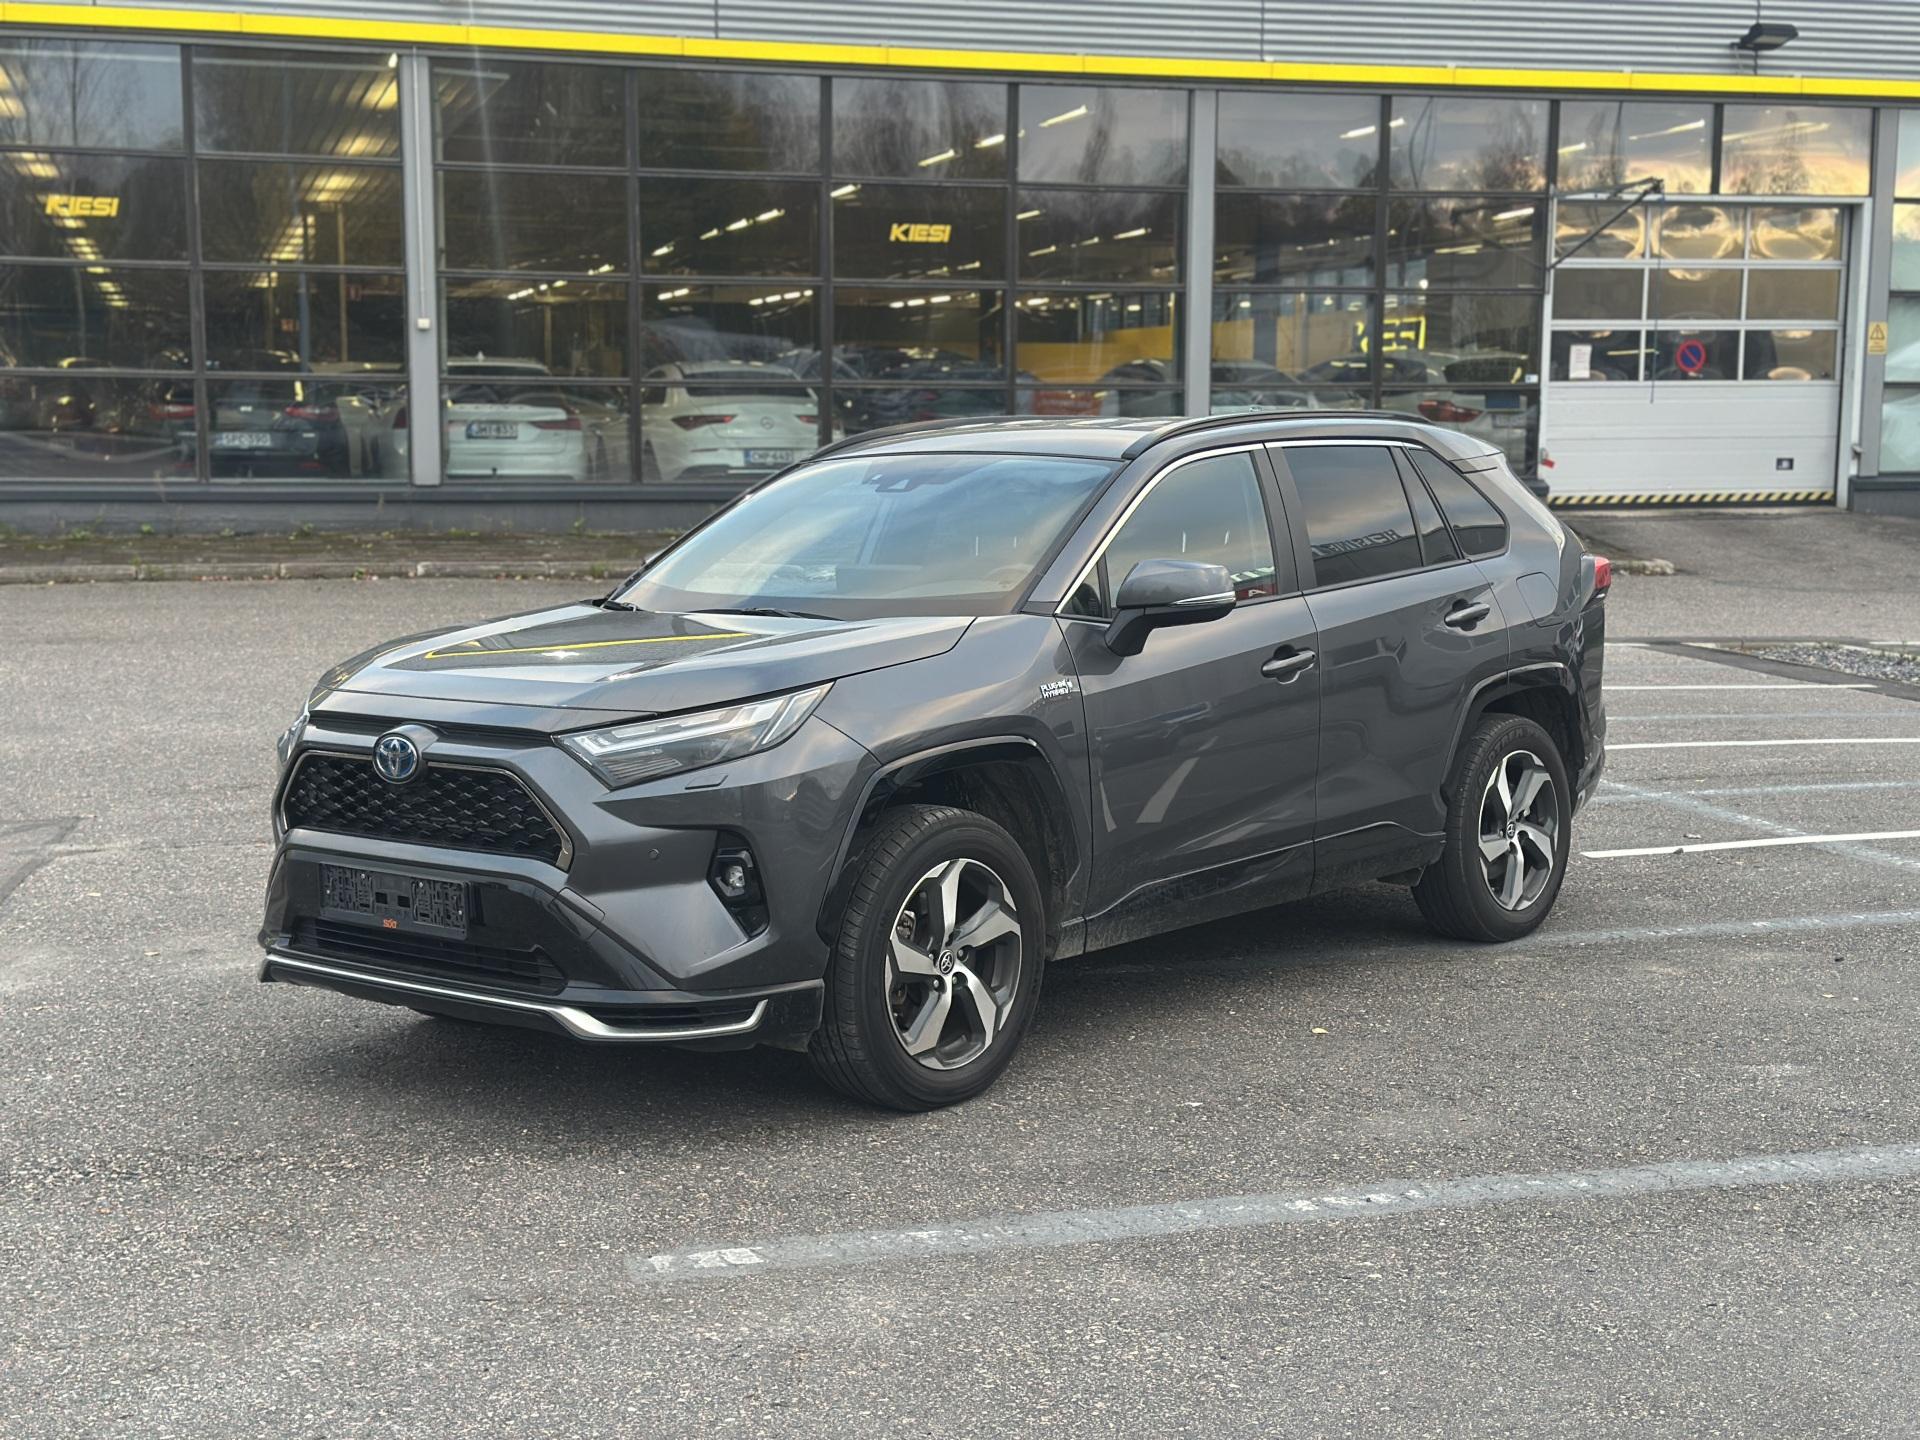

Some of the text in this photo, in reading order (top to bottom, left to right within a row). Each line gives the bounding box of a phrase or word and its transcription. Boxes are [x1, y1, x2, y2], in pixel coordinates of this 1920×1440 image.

[46, 193, 119, 217] KIESI
[889, 223, 952, 243] KIESI
[1042, 687, 1069, 699] HYBRID
